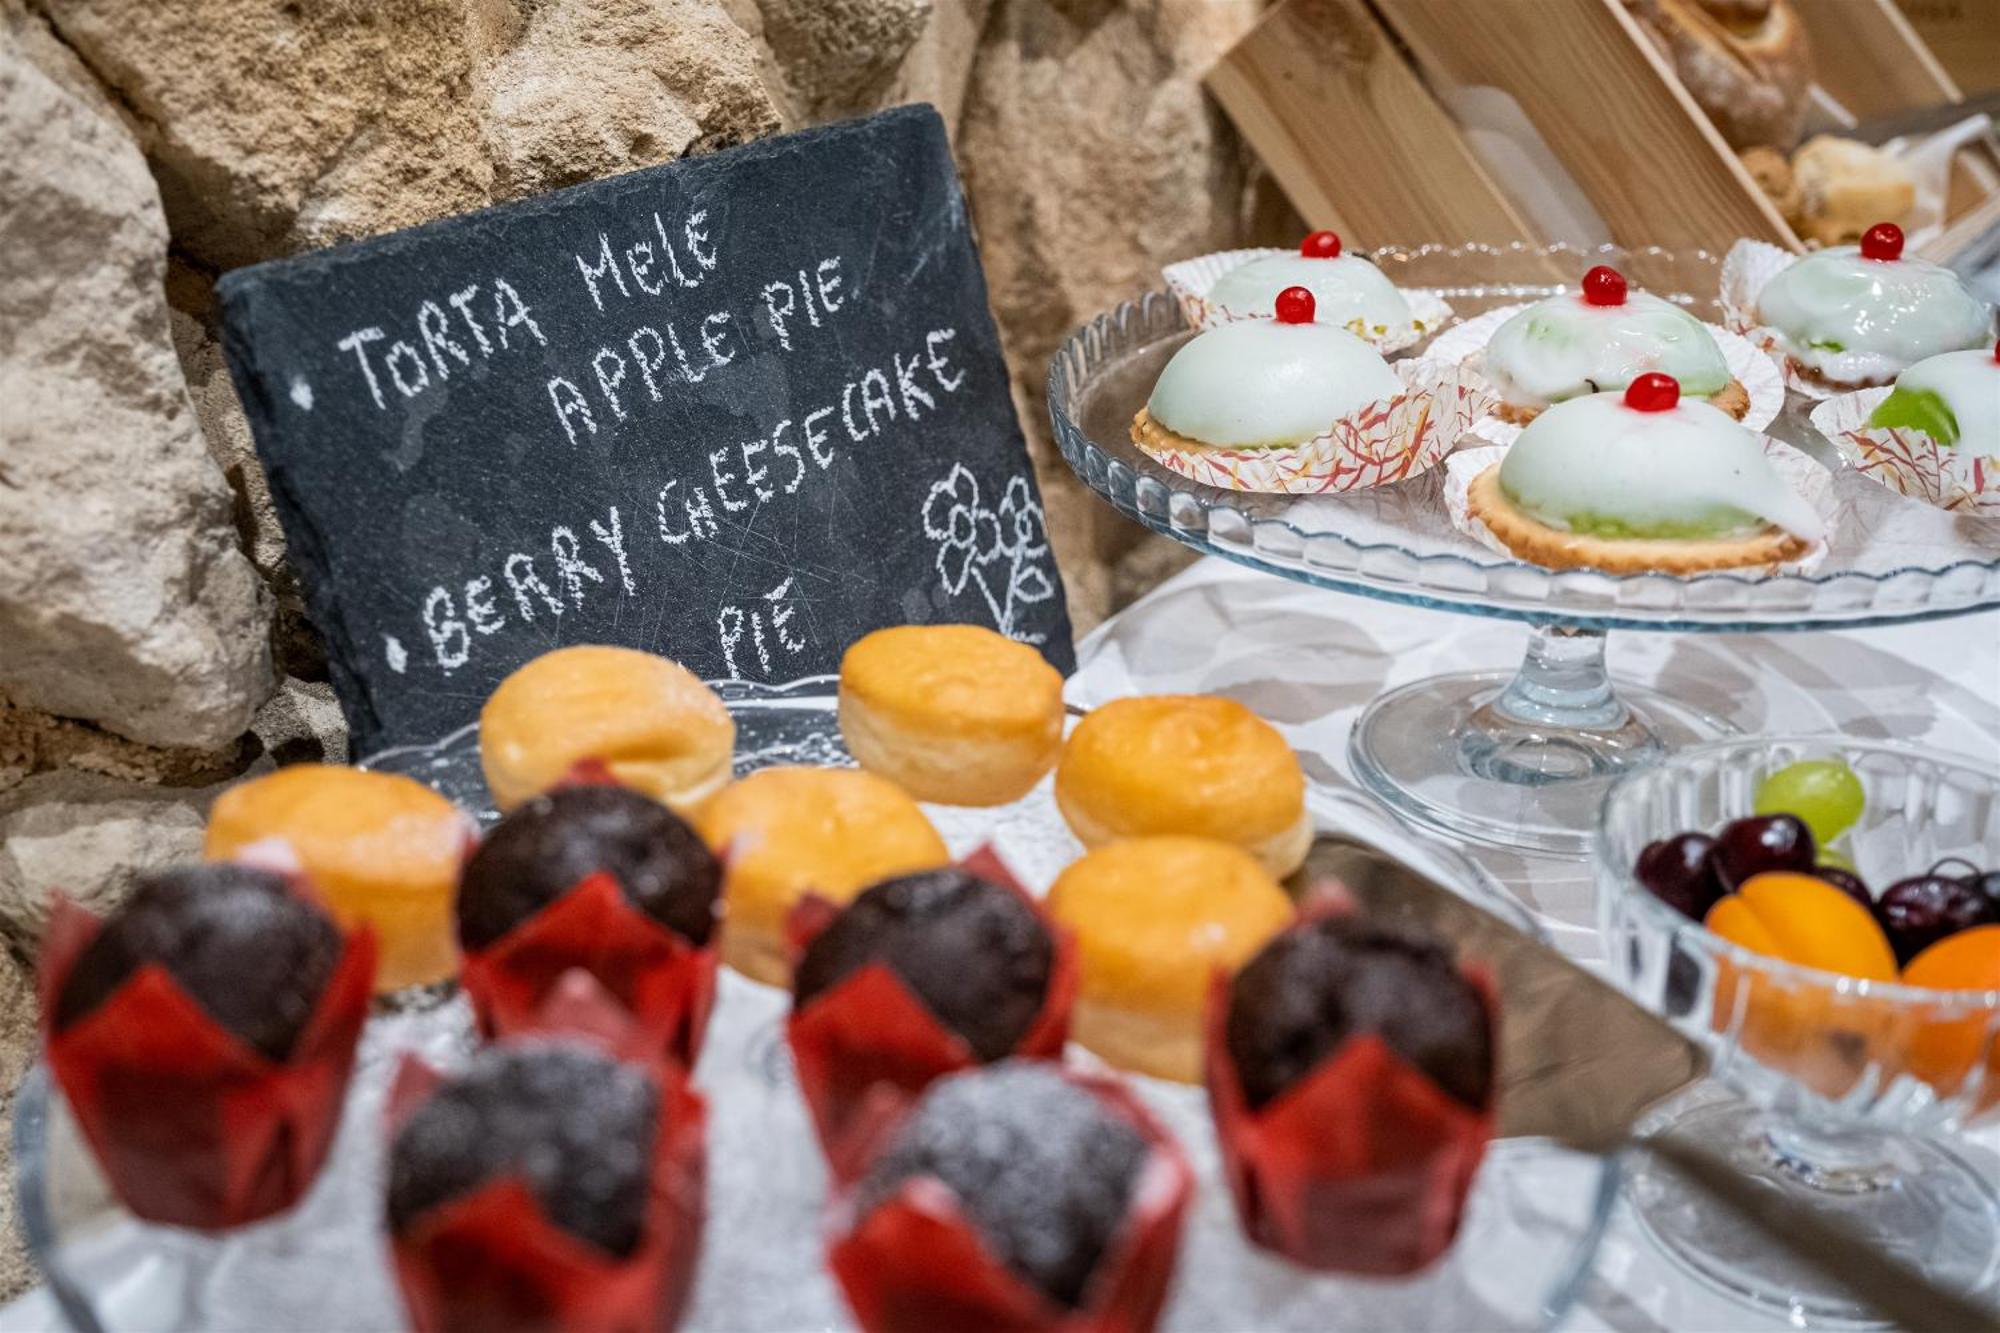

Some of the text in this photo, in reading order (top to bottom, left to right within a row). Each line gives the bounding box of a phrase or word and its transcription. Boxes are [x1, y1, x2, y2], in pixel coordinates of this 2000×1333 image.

[338, 277, 549, 410] TORTA
[546, 256, 845, 445] APPLE PIE
[422, 328, 966, 675] BERRY CHEESECAKE
[717, 576, 806, 681] PIE
